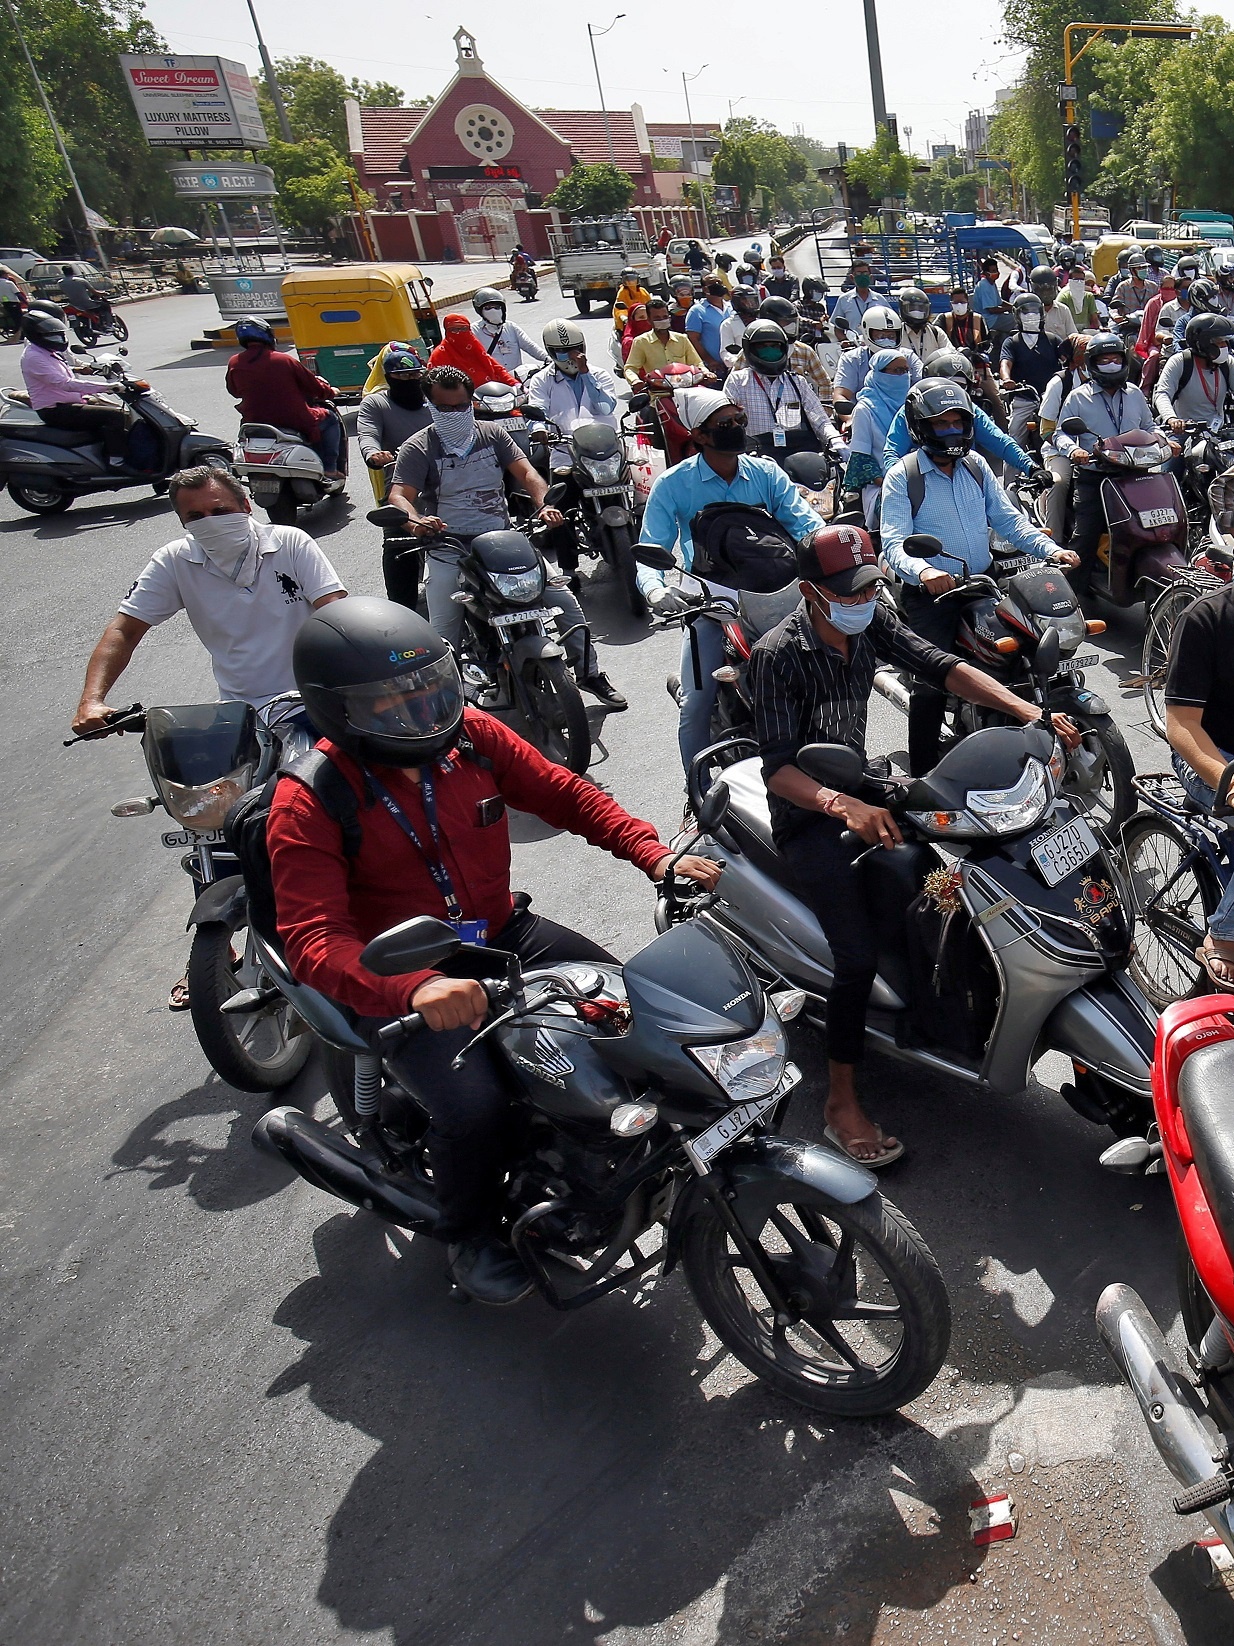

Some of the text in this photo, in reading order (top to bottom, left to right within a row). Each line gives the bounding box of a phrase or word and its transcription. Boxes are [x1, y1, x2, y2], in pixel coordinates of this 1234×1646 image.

[164, 59, 176, 68] TF
[135, 71, 215, 84] Sweet Dream
[144, 112, 231, 122] LUXURY MATTRESS
[175, 126, 210, 136] PILLOW
[222, 176, 256, 188] A.C.T.P.
[221, 291, 279, 300] AHMEDABAD CITY
[225, 299, 278, 308] TRAFFIC POLICE
[1150, 509, 1168, 518] GJ27
[1060, 657, 1093, 671] 1MG3922
[1043, 825, 1081, 861] GJ27D
[1053, 842, 1090, 876] C3650
[1090, 900, 1120, 924] BAPU
[1172, 925, 1190, 941] STITCH
[722, 990, 752, 1012] HONDA
[1195, 1030, 1220, 1040] Hero
[514, 1052, 568, 1090] HONDA
[704, 1147, 715, 1156] IND
